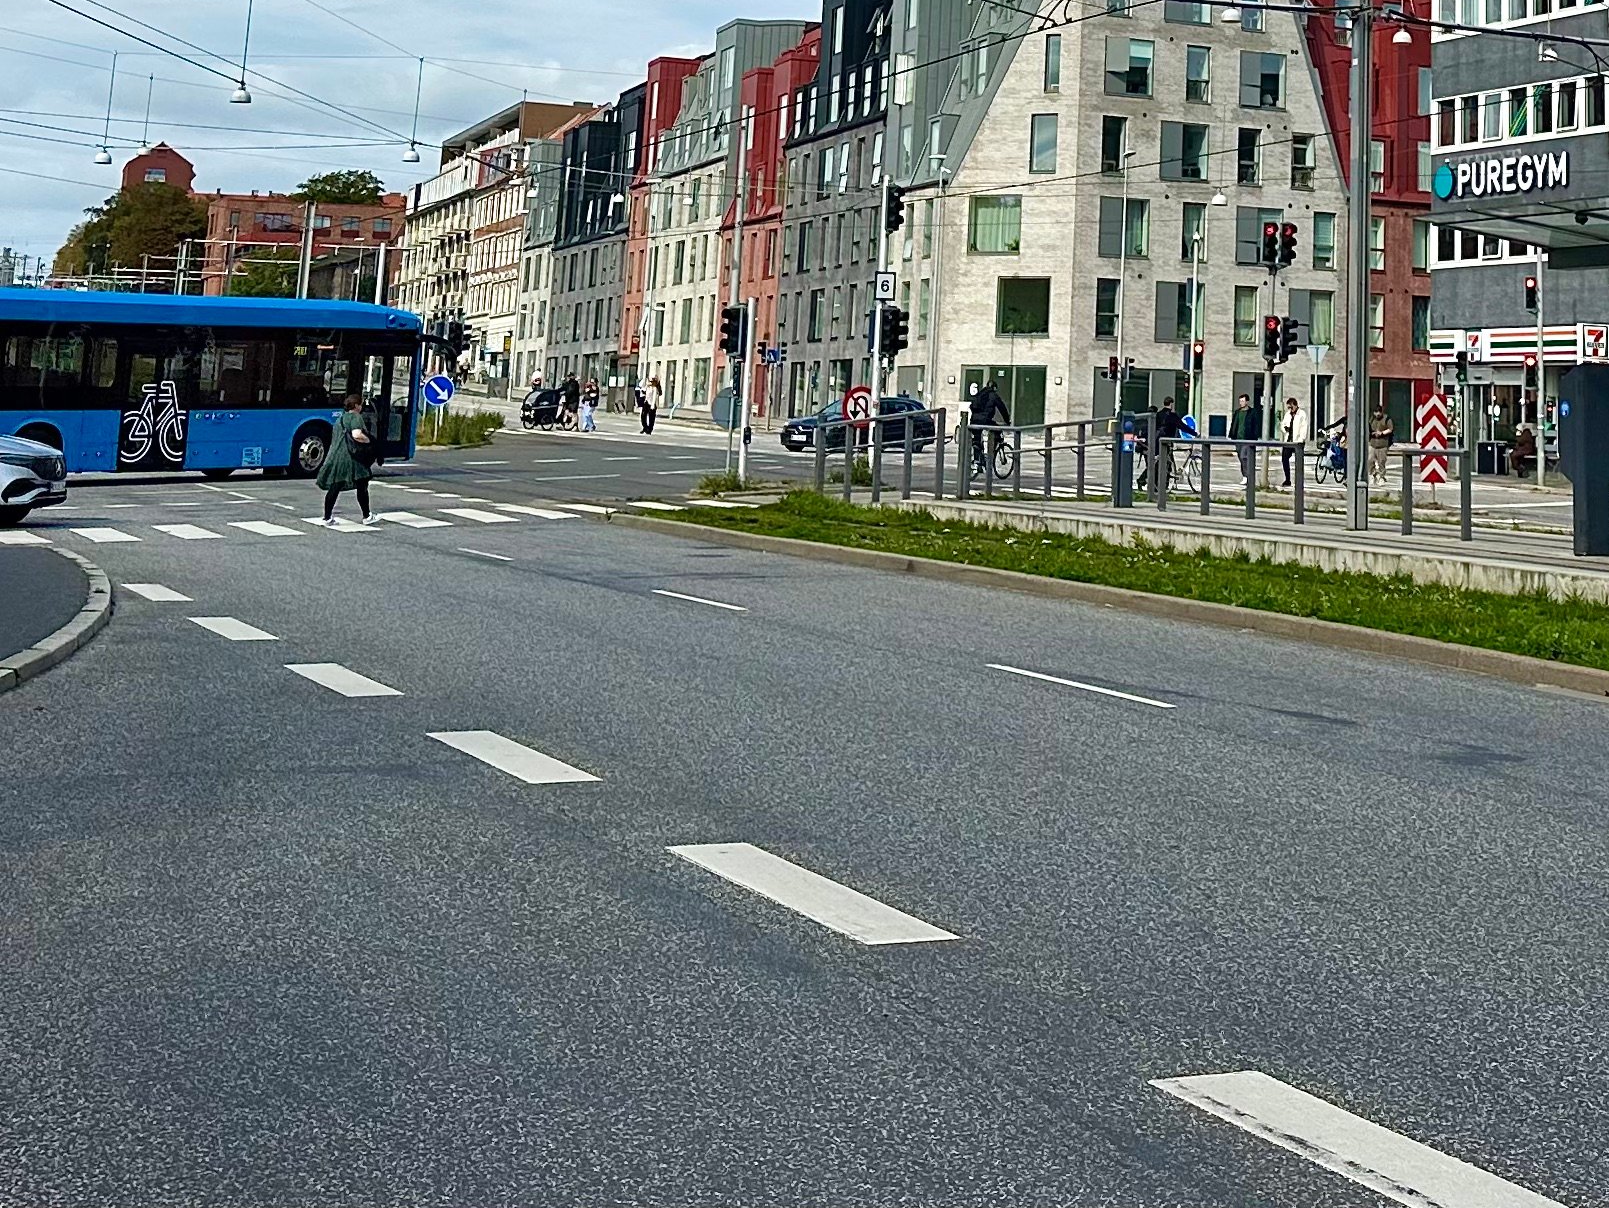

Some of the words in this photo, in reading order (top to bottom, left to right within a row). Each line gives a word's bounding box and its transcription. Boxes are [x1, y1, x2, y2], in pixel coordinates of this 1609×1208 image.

[1457, 150, 1567, 197] PUREGYM
[881, 279, 890, 293] 6
[1588, 329, 1604, 356] 7
[969, 383, 979, 396] 6
